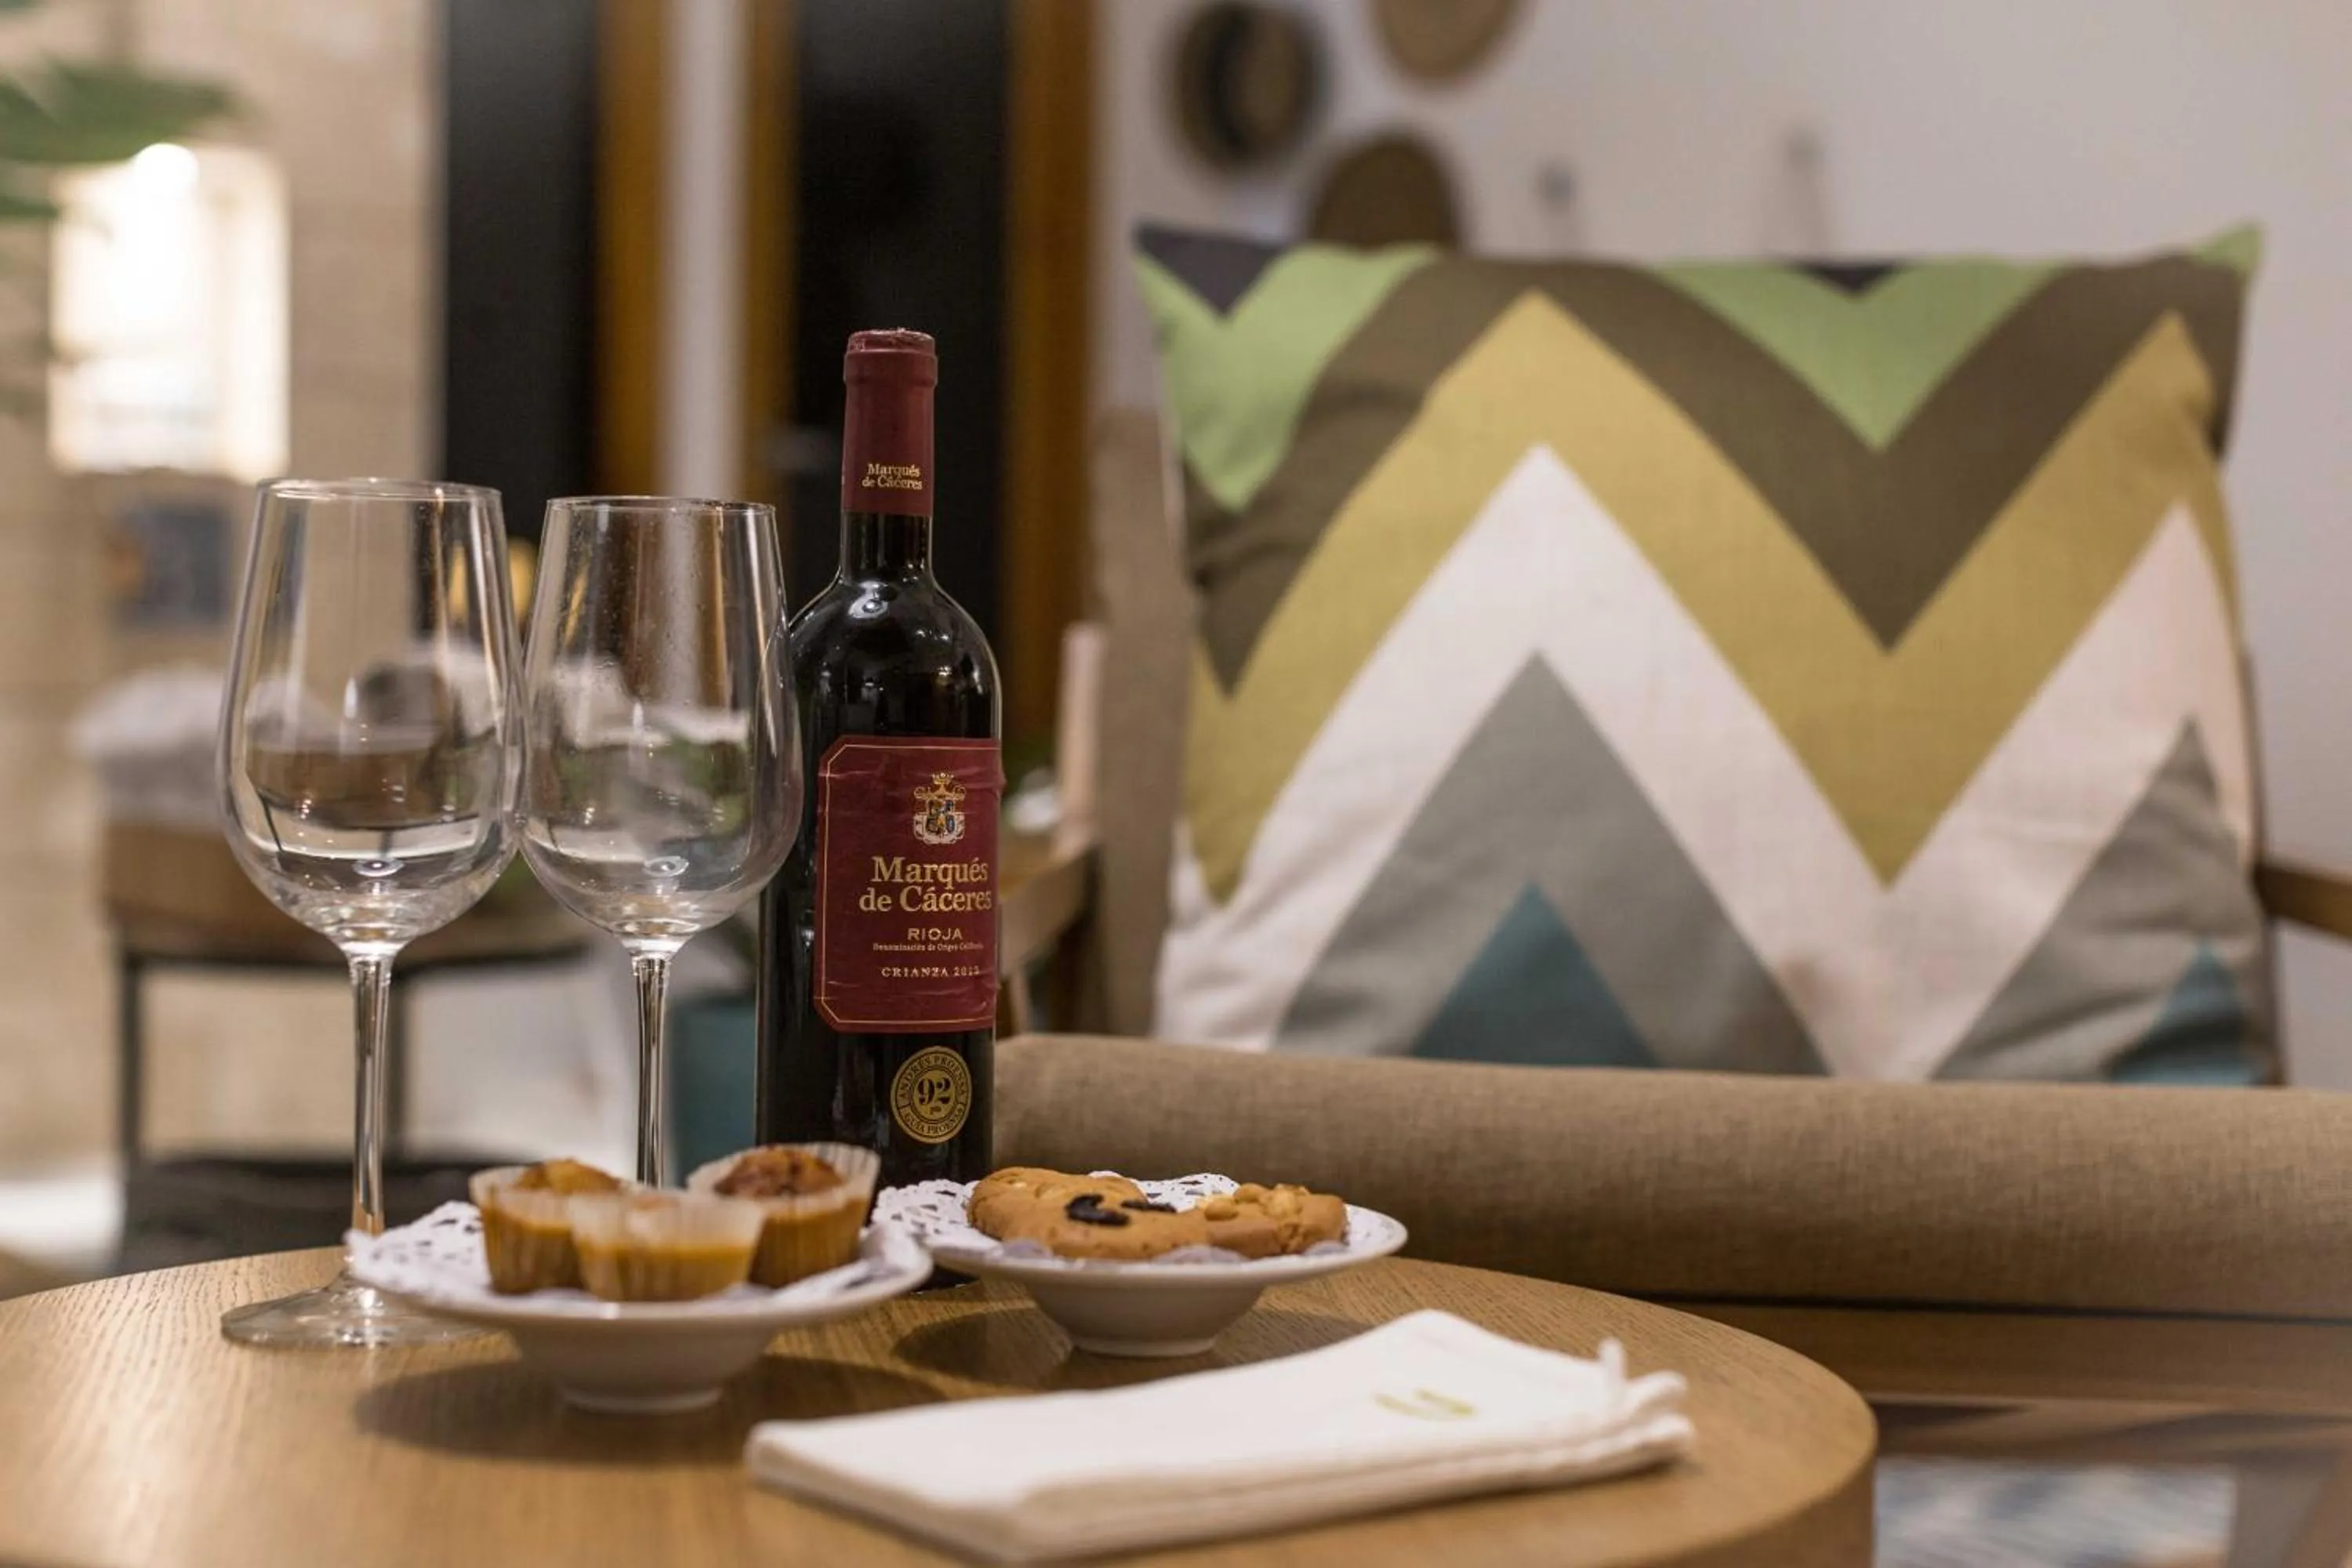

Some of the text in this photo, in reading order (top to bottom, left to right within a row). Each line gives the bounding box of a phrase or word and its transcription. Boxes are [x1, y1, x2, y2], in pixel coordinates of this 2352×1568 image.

[862, 476, 876, 487] de
[870, 855, 988, 890] Marqués
[858, 885, 992, 912] de Cáceres
[906, 927, 964, 940] RIOJA
[881, 967, 949, 978] CRIANZA
[918, 1078, 952, 1105] 92
